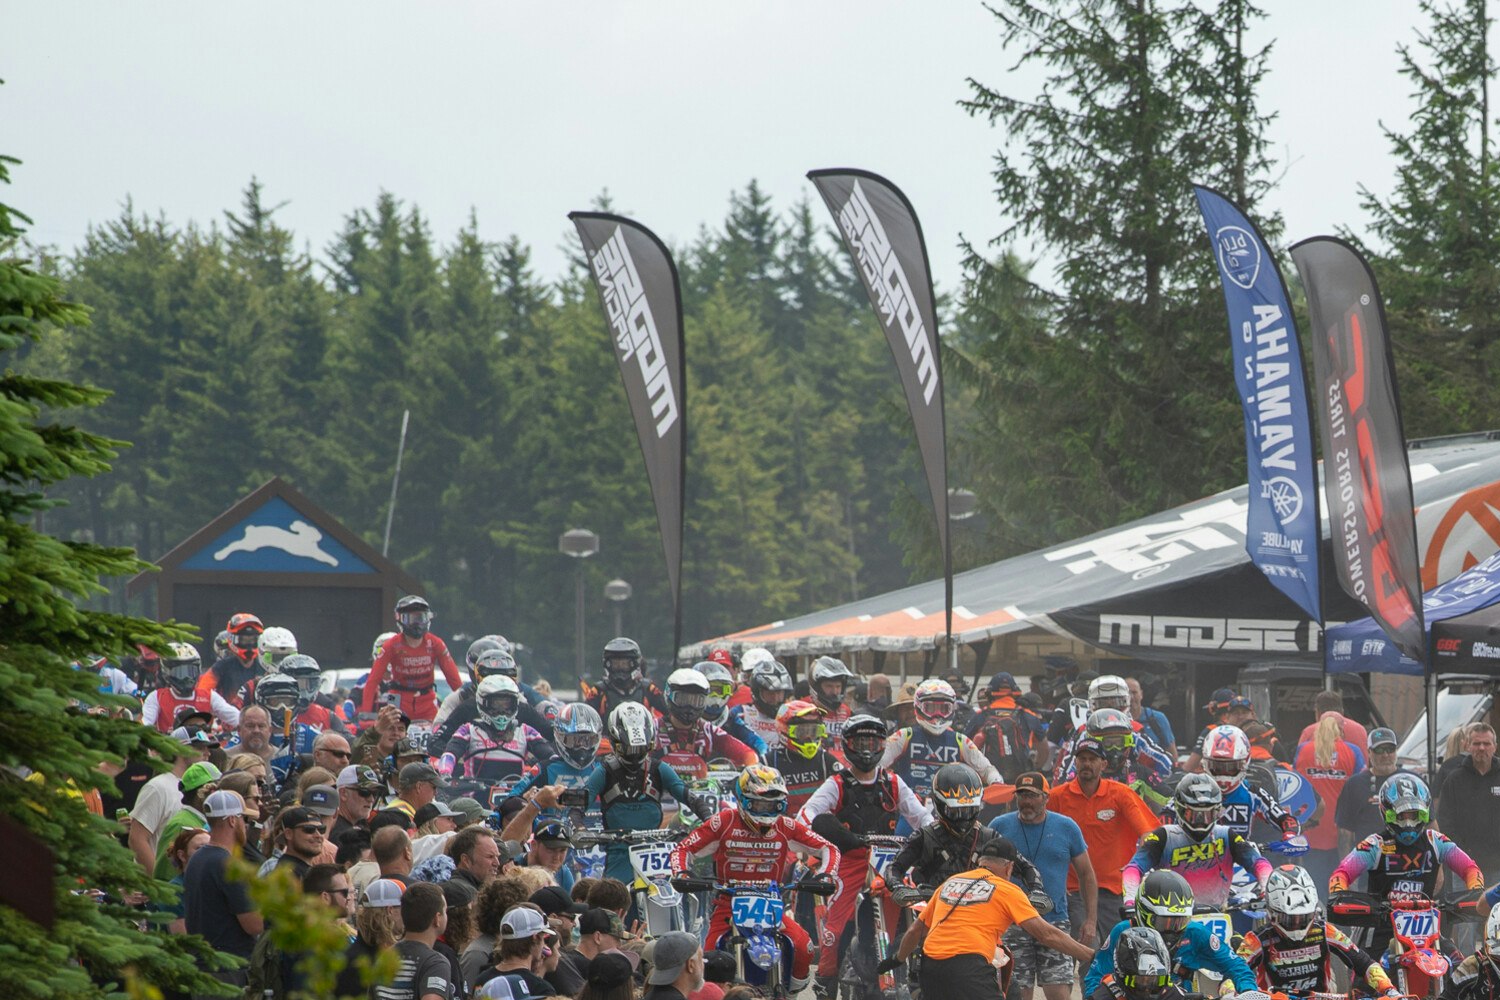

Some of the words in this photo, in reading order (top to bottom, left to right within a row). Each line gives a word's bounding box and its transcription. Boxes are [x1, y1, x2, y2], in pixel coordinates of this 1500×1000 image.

[1101, 614, 1298, 651] MOOSE
[1436, 638, 1462, 651] GBC
[910, 742, 959, 763] FXR
[785, 771, 819, 786] EVEN
[1221, 804, 1249, 823] XR
[1171, 838, 1225, 867] FXR
[732, 897, 784, 926] 545
[1401, 915, 1434, 936] 707
